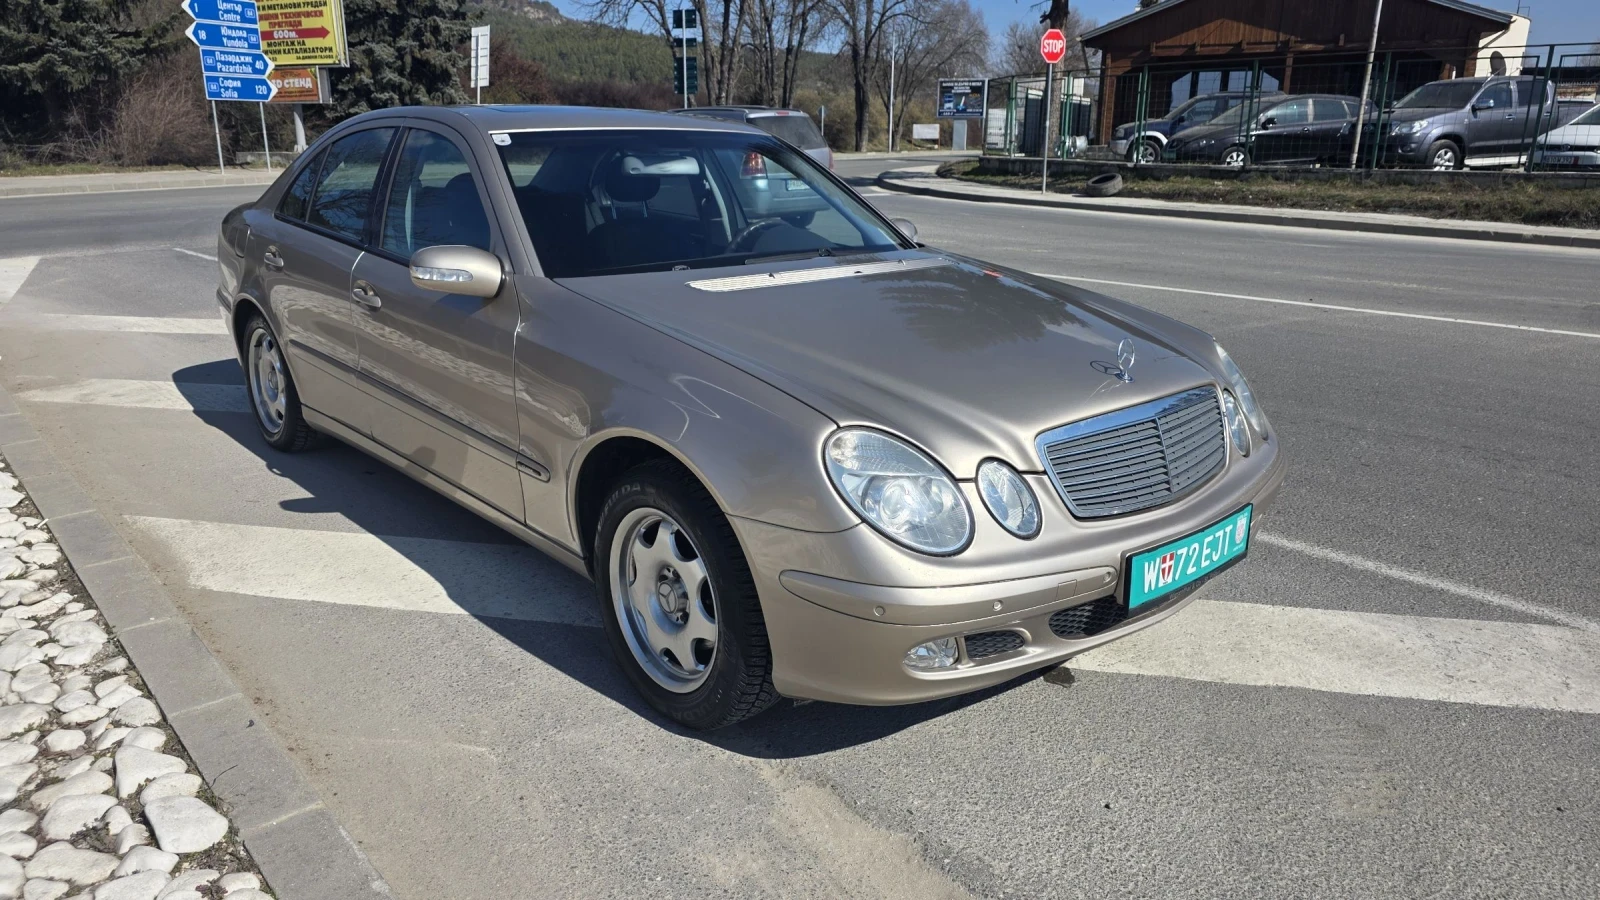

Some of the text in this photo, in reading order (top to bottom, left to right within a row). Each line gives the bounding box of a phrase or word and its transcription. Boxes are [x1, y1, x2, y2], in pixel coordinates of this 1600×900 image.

[194, 3, 198, 12] 1
[217, 0, 242, 12] Център
[267, 2, 302, 11] МЕТАНОВИ
[302, 0, 327, 8] УРЕДБИ
[219, 11, 241, 22] Centre
[198, 30, 206, 40] 18
[220, 26, 247, 37] Юндола
[222, 37, 248, 48] Yundola
[267, 40, 296, 48] МОНТАЖ
[1043, 39, 1063, 53] STOP
[283, 46, 333, 55] КАТАЛИЗАТОРИ
[215, 52, 253, 64] Пазарджик
[217, 63, 253, 73] Pazardzhik
[255, 60, 264, 70] 40
[219, 77, 241, 88] София
[283, 77, 312, 89] СТЕНД
[220, 88, 238, 98] Sofia
[255, 85, 267, 95] 120
[1144, 557, 1160, 594] W
